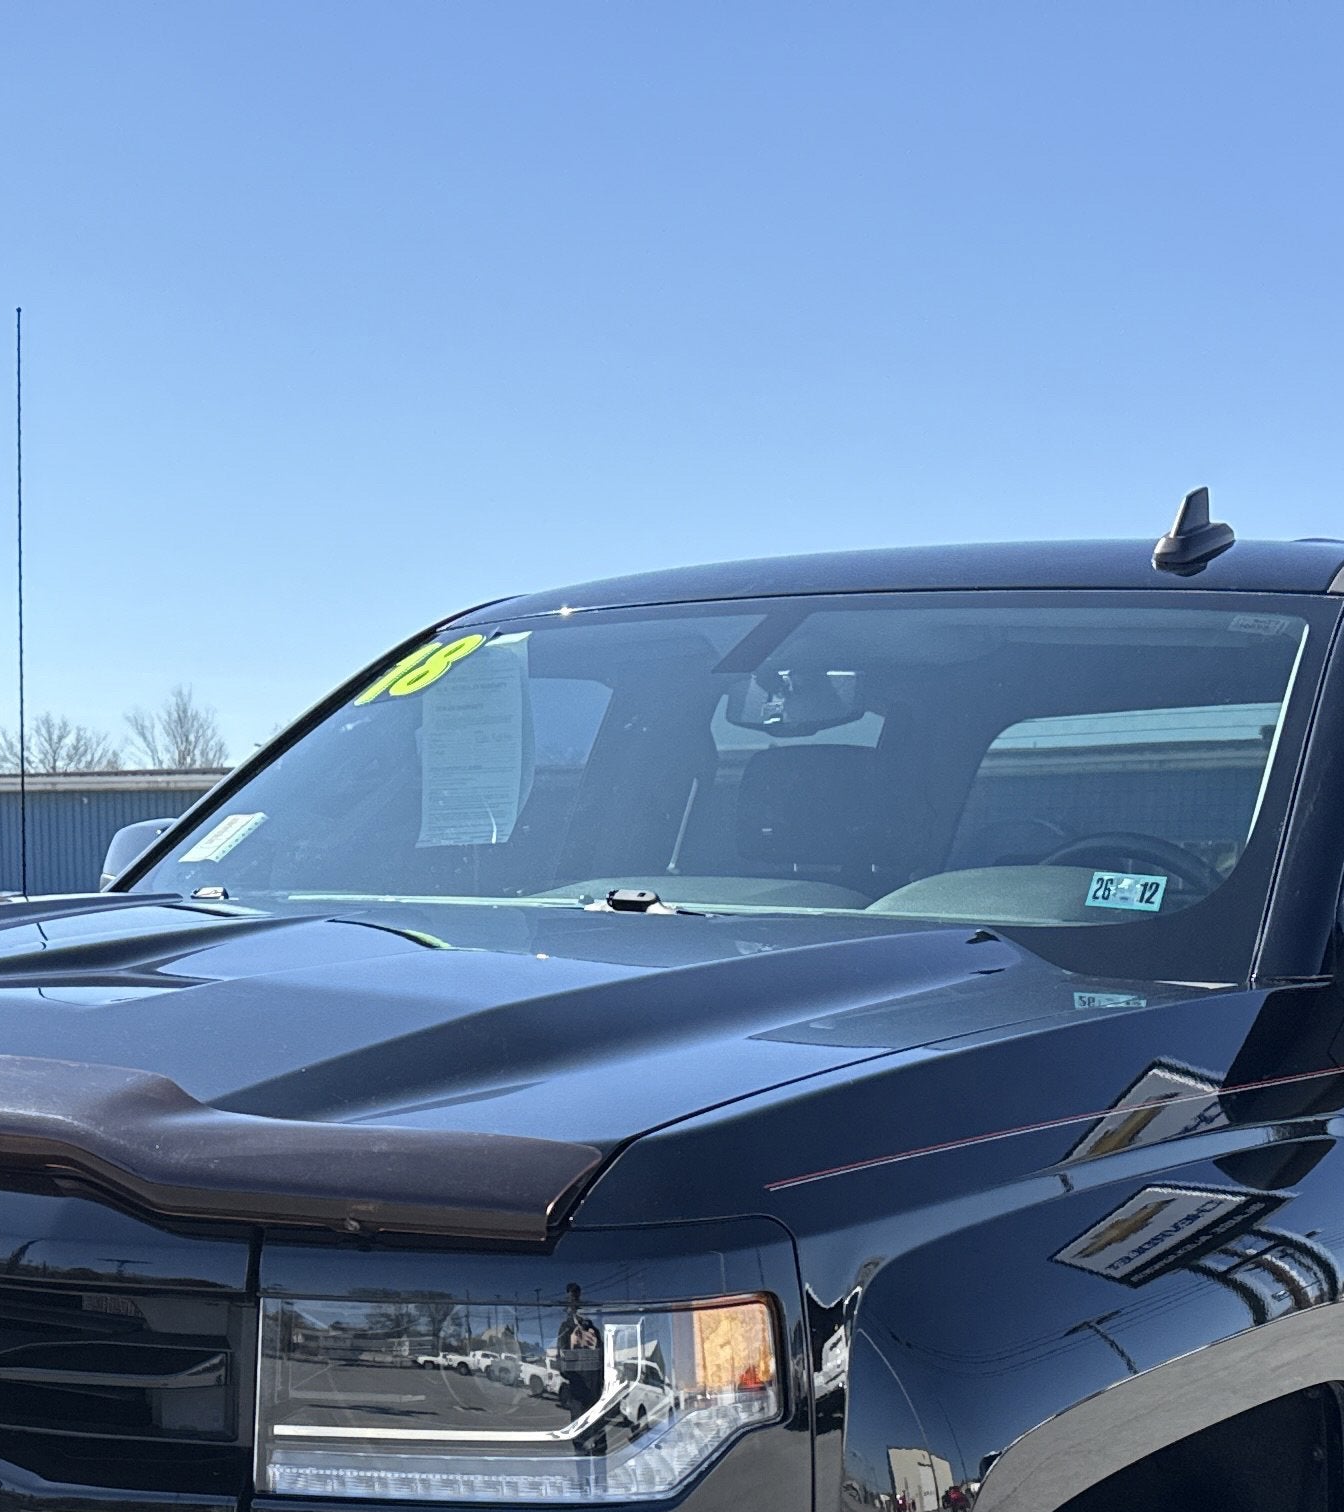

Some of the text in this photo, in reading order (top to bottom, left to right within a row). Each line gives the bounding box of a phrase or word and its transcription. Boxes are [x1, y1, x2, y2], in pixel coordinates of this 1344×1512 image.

[354, 632, 487, 706] 18
[1092, 877, 1160, 905] 26 12
